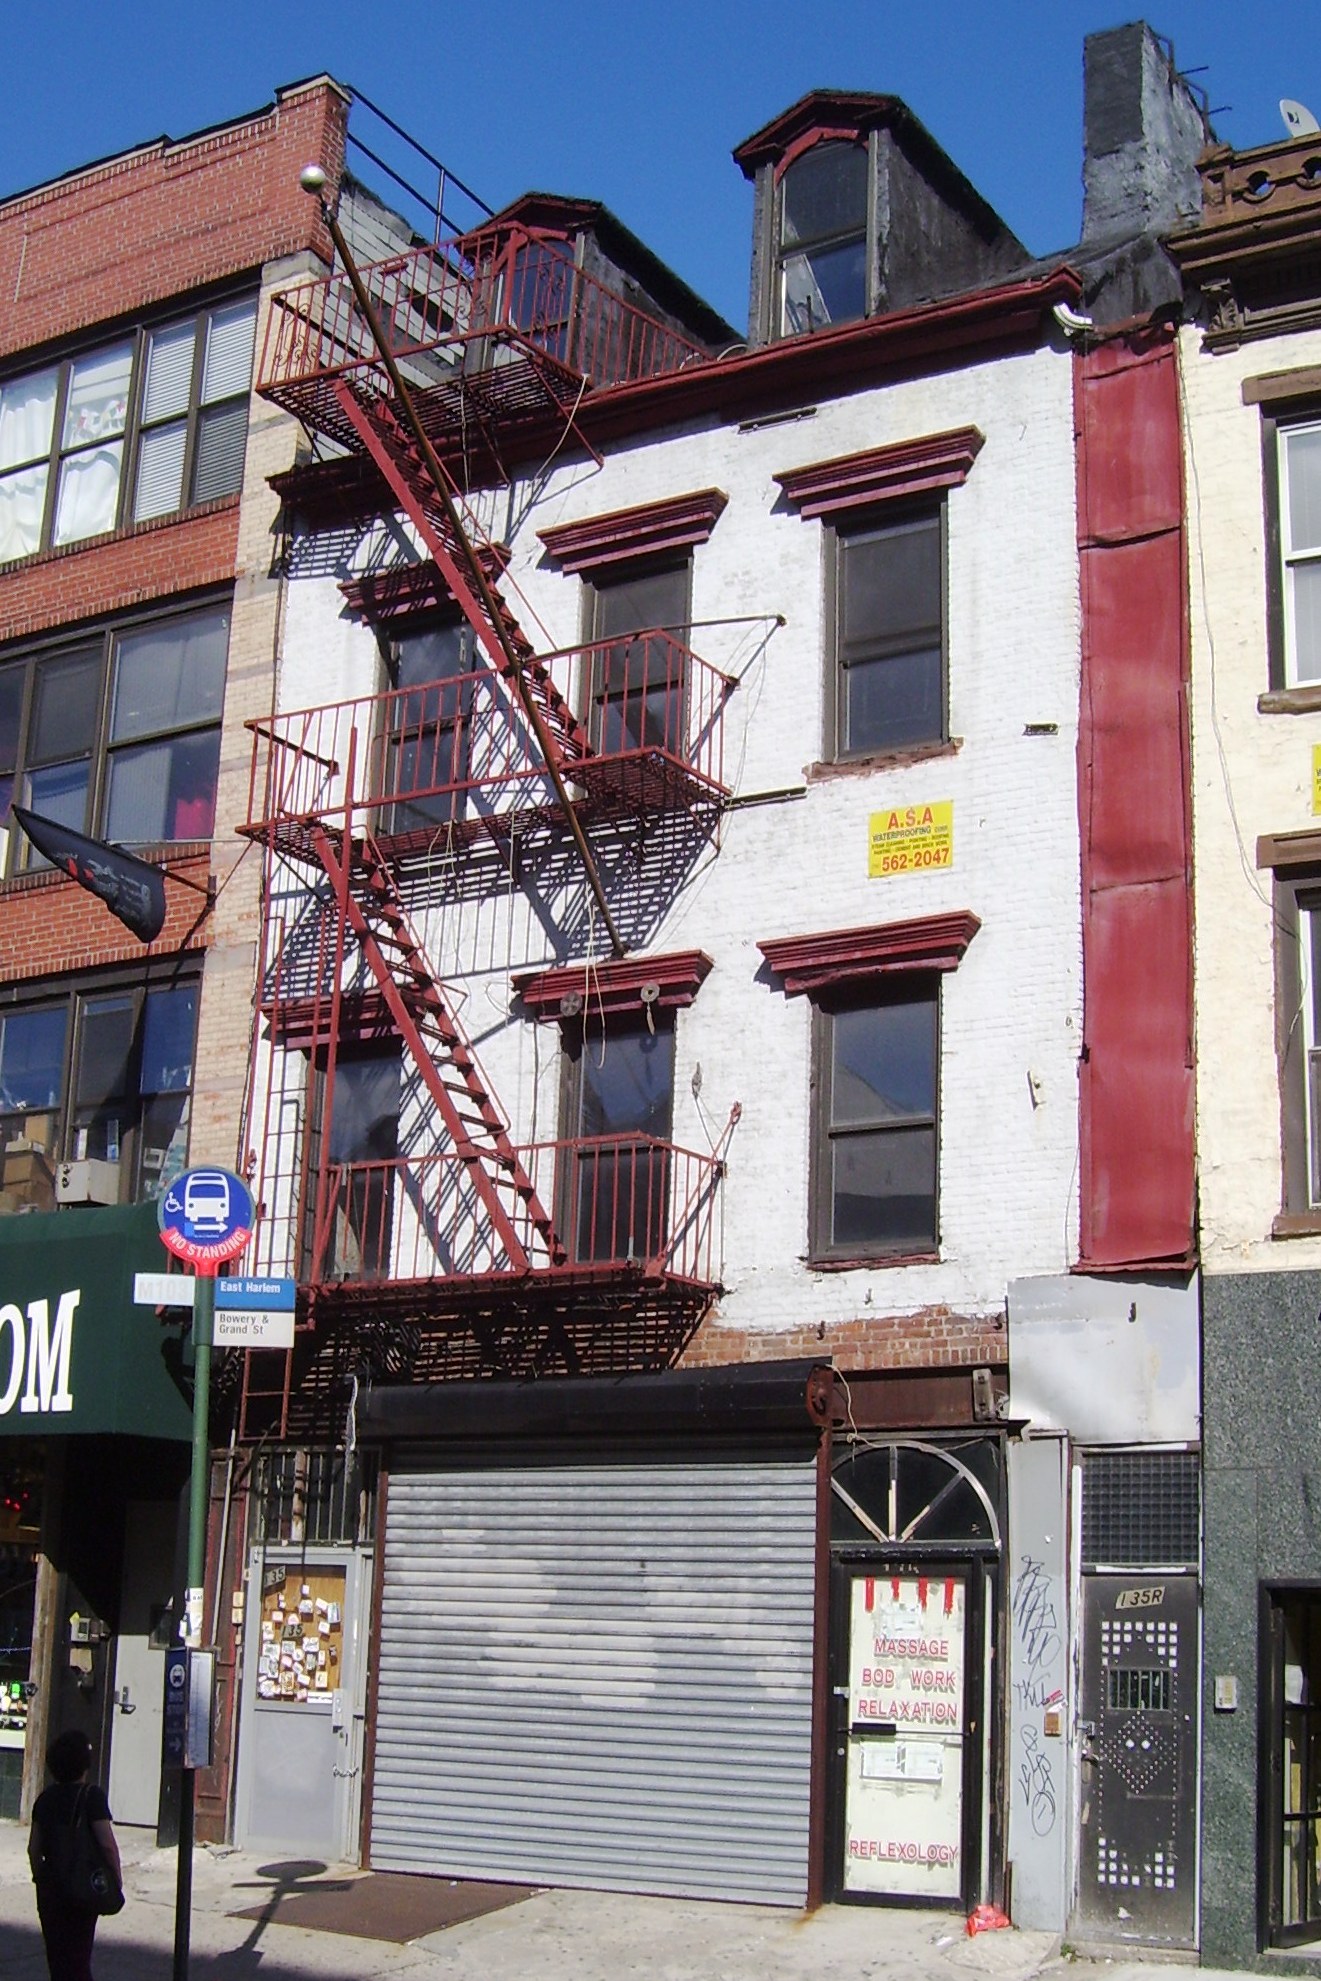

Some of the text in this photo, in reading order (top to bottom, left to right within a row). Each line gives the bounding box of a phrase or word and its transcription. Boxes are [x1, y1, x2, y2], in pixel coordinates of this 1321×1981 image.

[882, 847, 950, 872] 562-2047
[168, 1229, 247, 1259] NO STANDING
[220, 1280, 281, 1294] East Harlem
[219, 1313, 270, 1326] Bowery &
[219, 1325, 264, 1335] Grand St
[1120, 1589, 1163, 1607] 135R
[282, 1624, 303, 1637] 135
[873, 1637, 949, 1656] MASSAGE
[862, 1668, 956, 1687] BOD WORK
[858, 1699, 958, 1719] RELAXATION
[850, 1840, 959, 1861] REFLEXOLOGY
